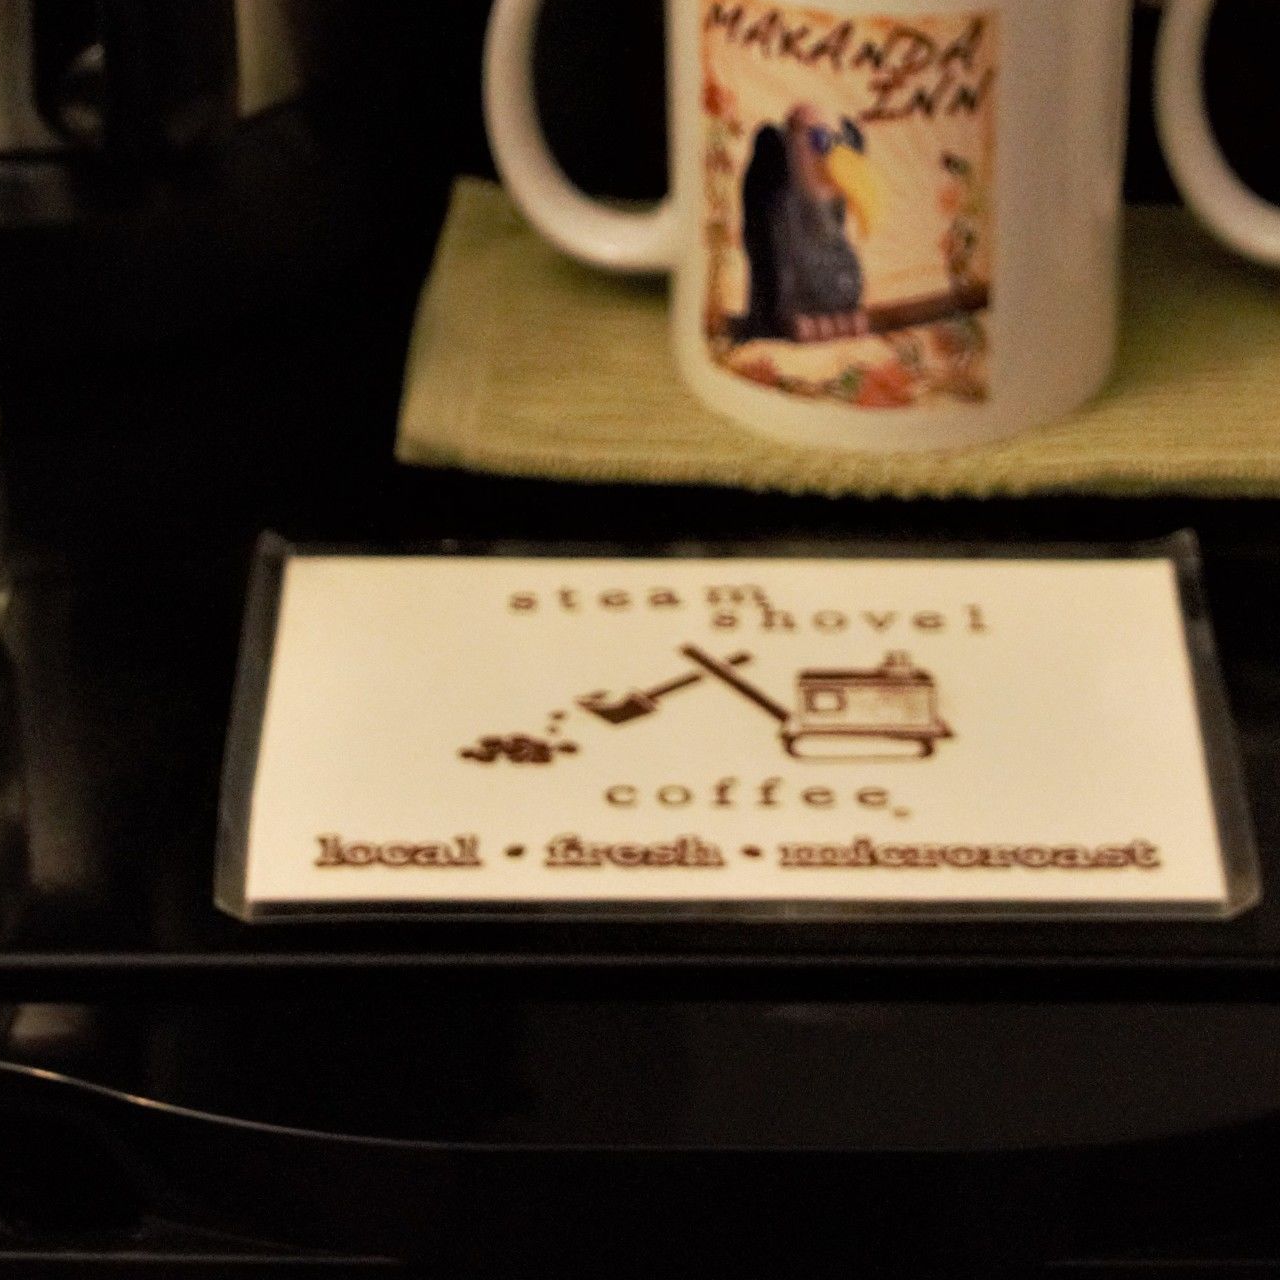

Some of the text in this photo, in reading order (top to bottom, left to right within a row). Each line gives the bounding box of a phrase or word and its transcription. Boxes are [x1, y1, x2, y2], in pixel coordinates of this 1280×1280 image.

[705, 0, 984, 82] MAKANDA
[856, 65, 997, 122] INN
[508, 584, 770, 614] steam
[712, 600, 990, 634] shovel
[314, 830, 1162, 870] local fresh microroast
